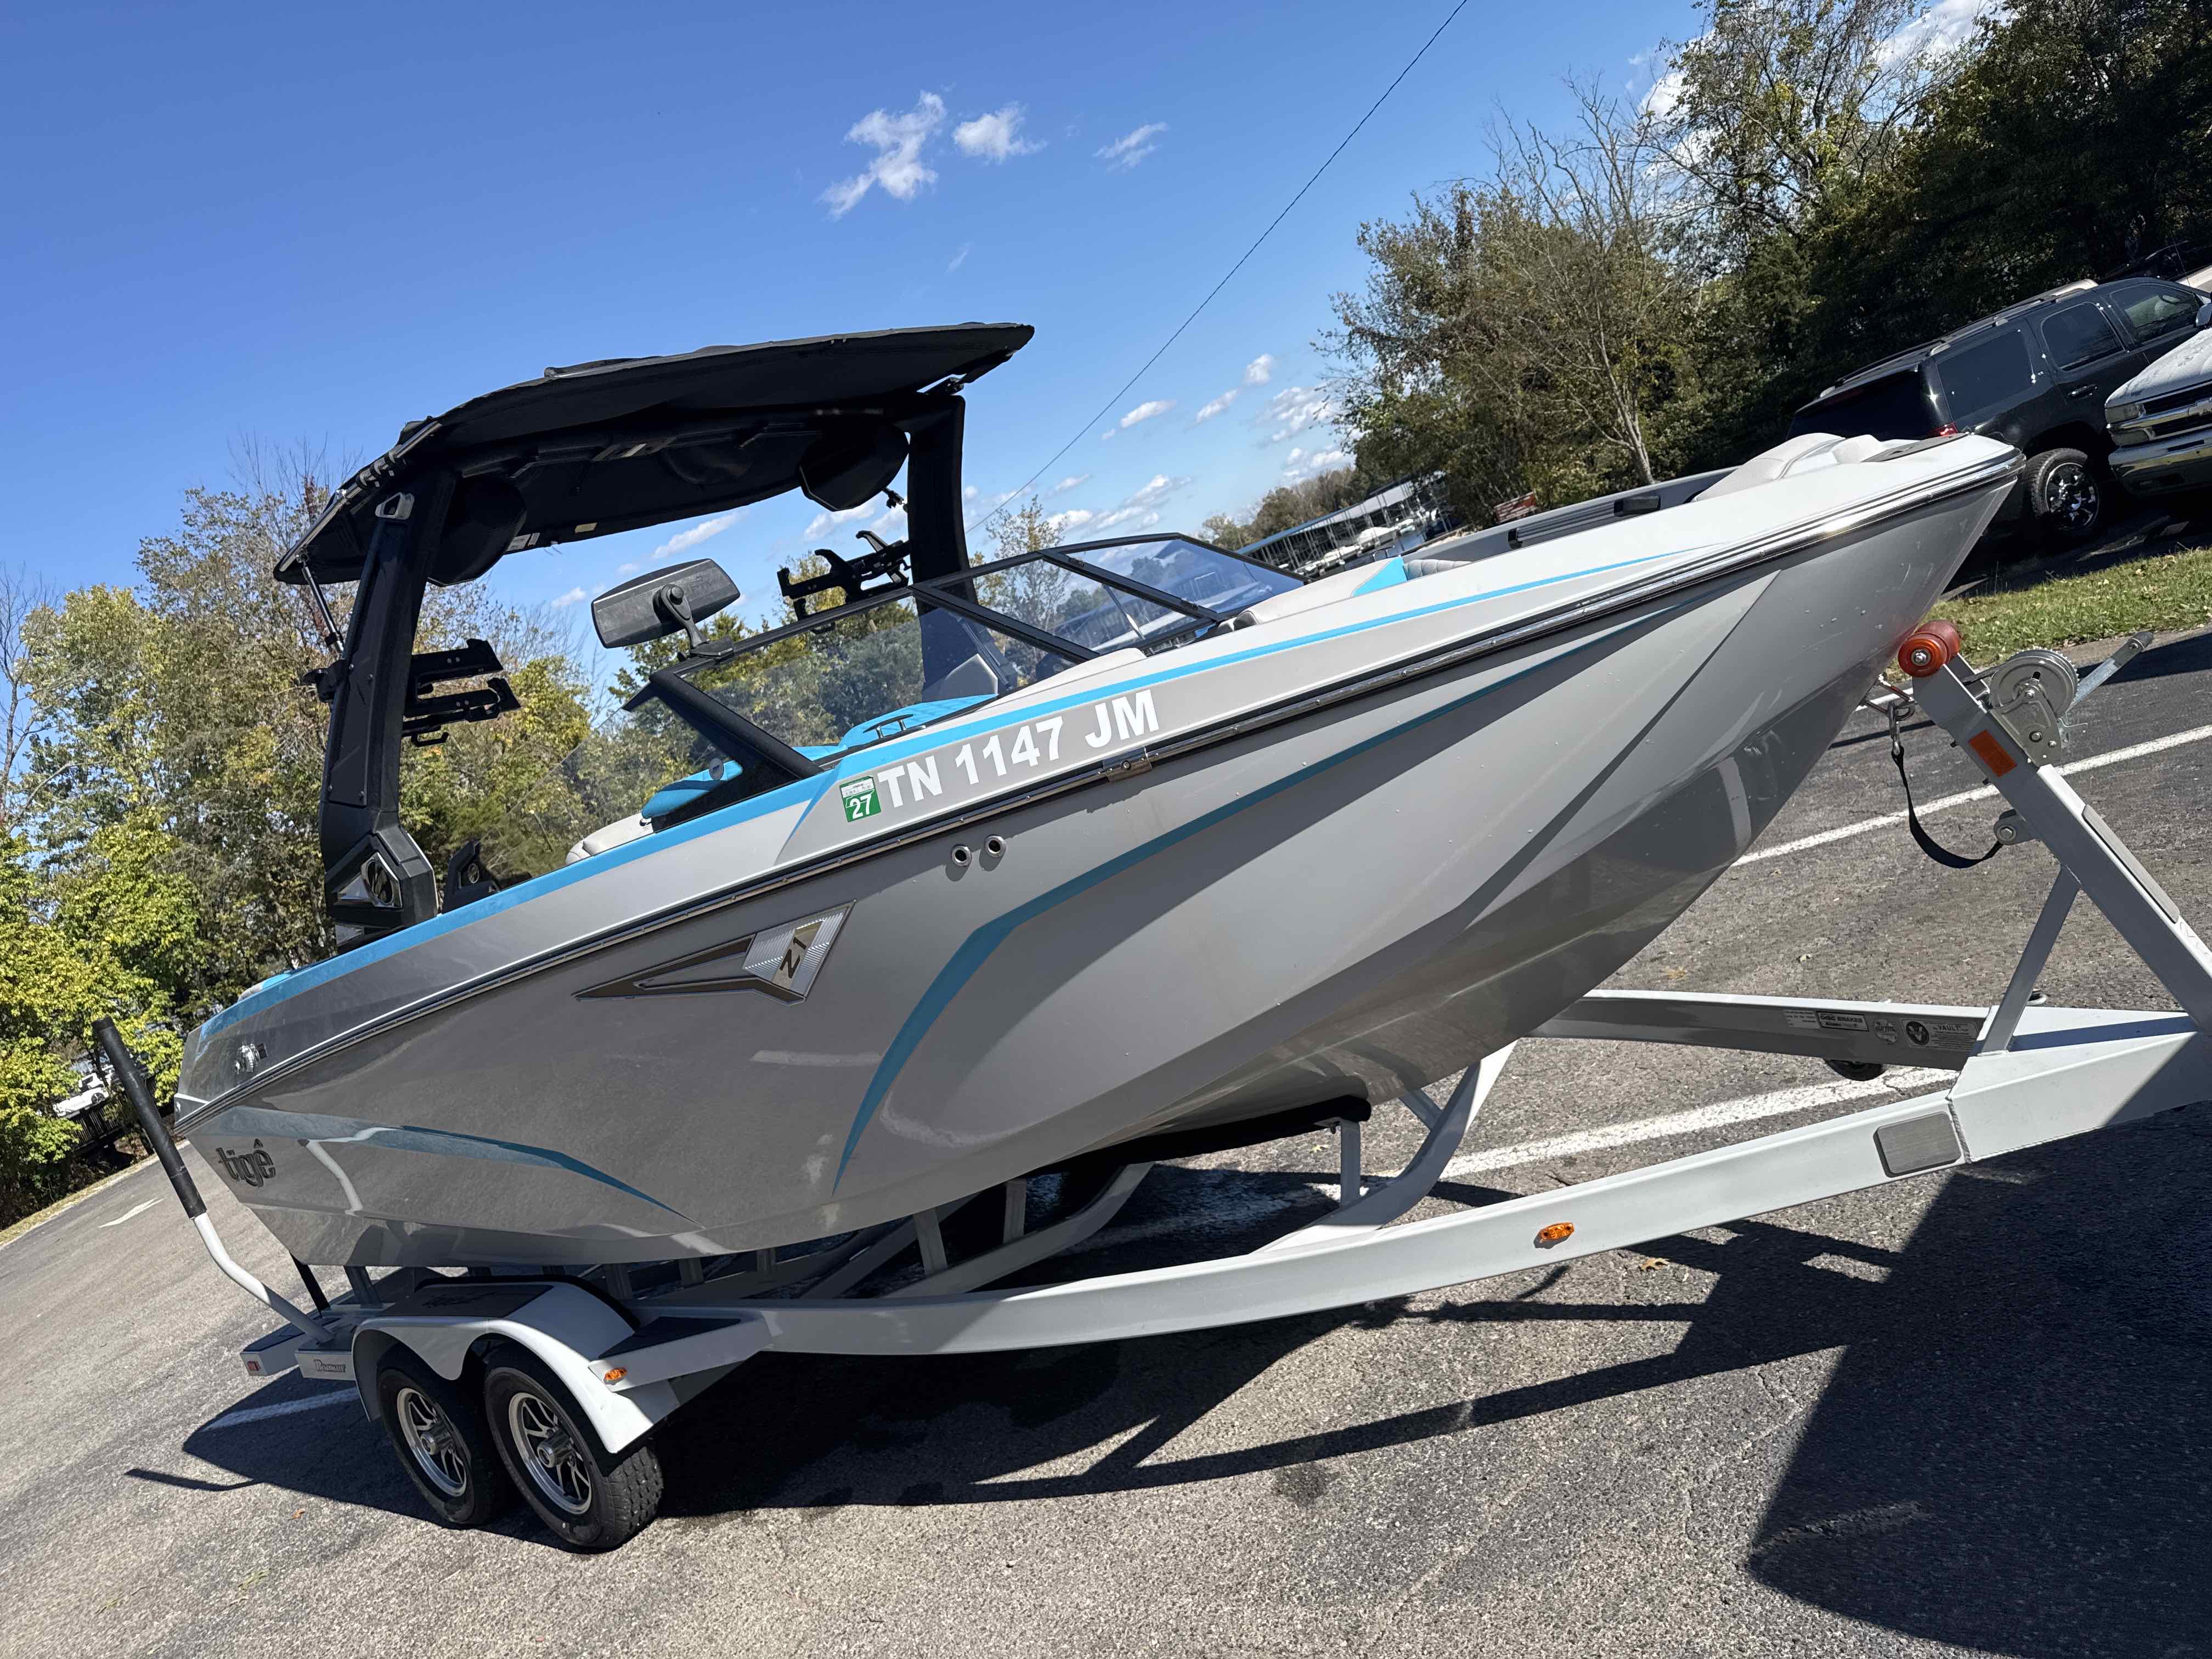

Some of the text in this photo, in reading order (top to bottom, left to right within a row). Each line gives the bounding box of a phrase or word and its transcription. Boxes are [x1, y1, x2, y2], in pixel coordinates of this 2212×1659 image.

[877, 689, 1159, 808] TN 1147 JM
[850, 793, 872, 819] 27
